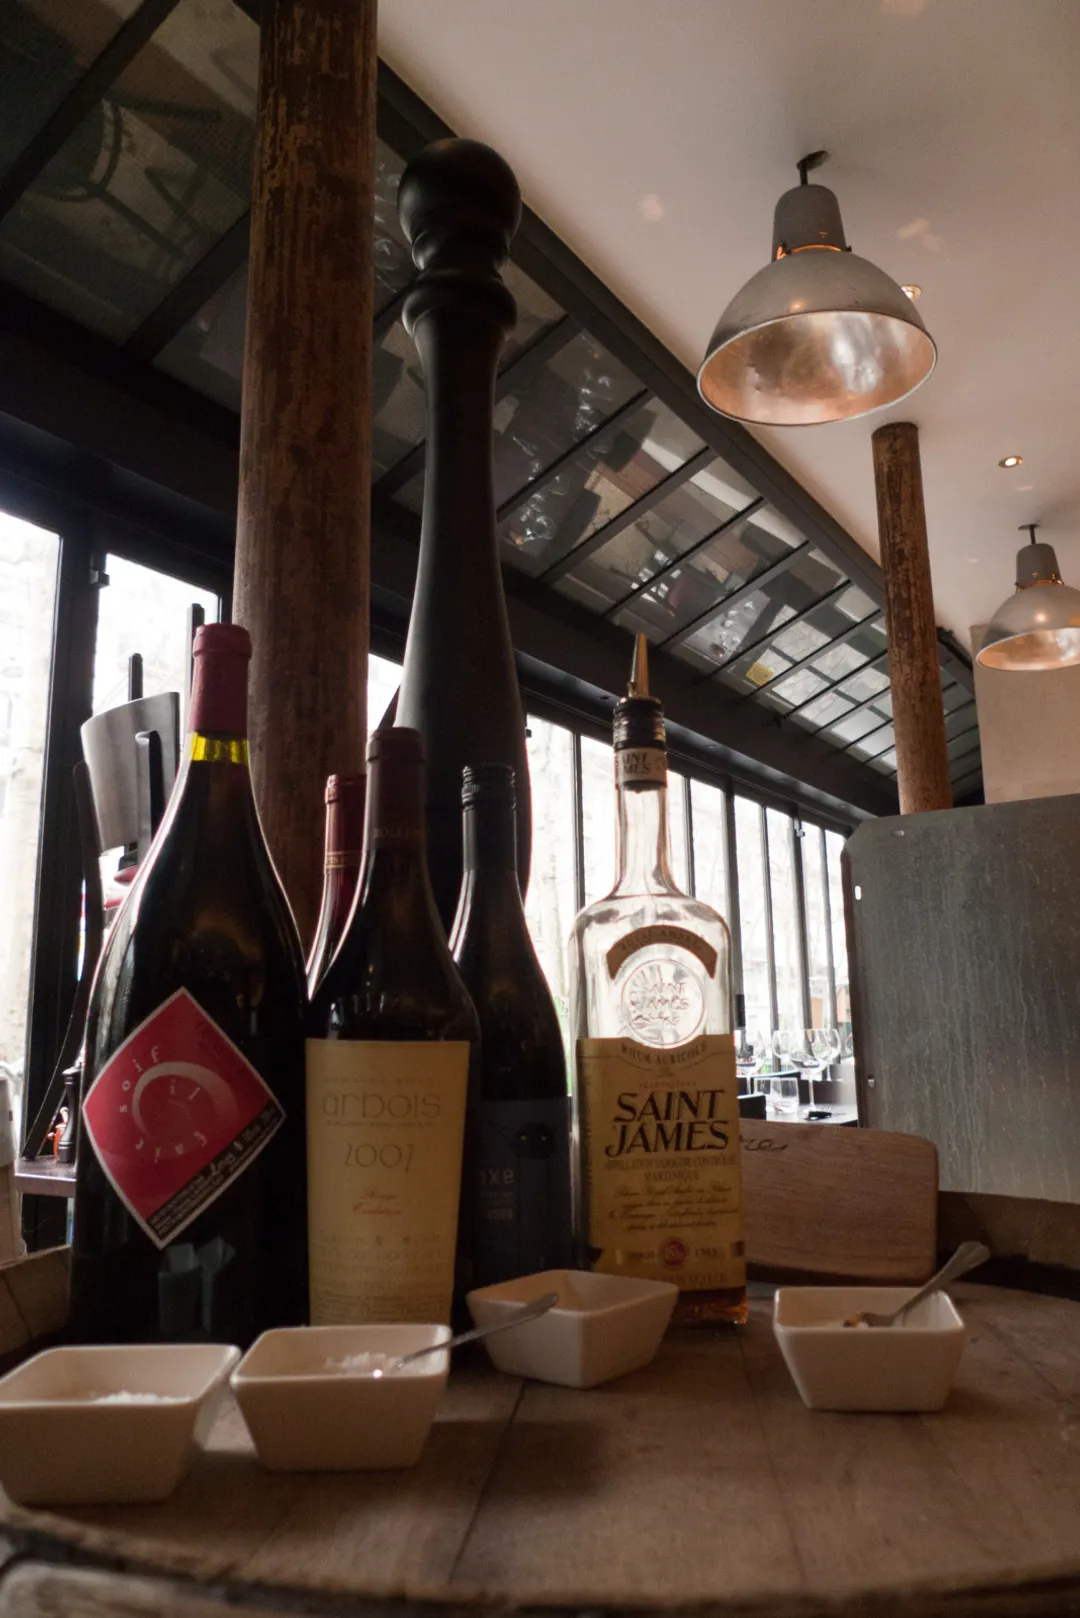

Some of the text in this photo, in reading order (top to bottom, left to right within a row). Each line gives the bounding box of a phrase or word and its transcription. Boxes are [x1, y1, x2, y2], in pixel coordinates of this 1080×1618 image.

[620, 1040, 709, 1066] RHUM AGRICOLE
[322, 1091, 442, 1119] arbois
[613, 1089, 726, 1123] SAINT
[605, 1120, 729, 1158] JAMES
[644, 1169, 700, 1182] MARTINIQUE
